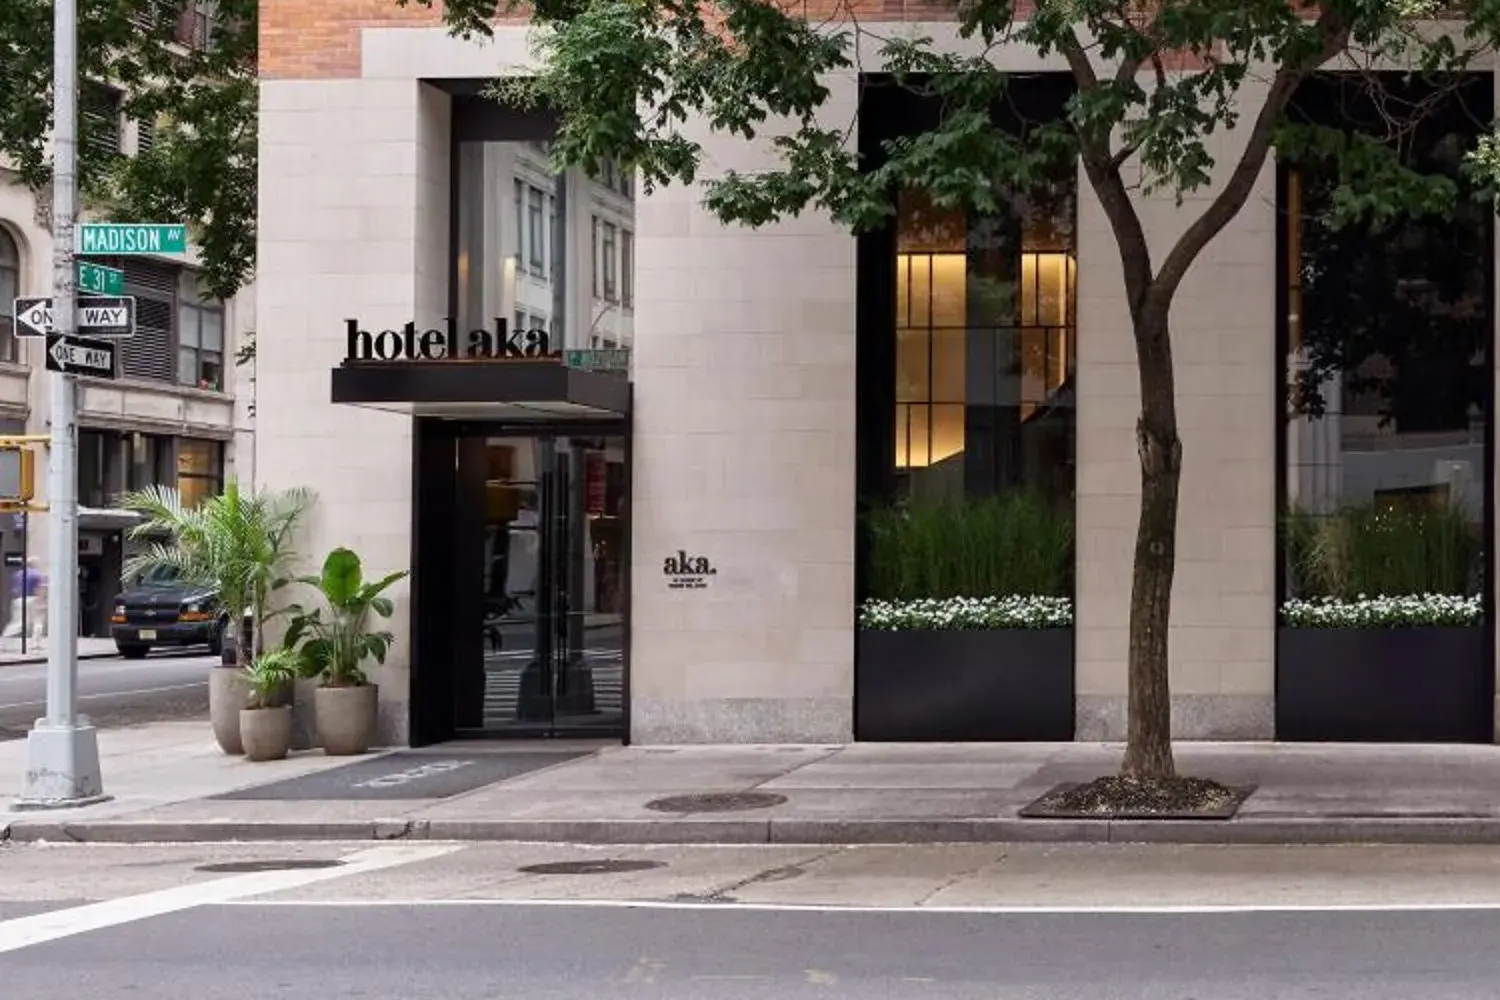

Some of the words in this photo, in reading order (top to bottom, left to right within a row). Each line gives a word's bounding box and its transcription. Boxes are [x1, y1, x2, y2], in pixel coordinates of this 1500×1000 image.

[83, 227, 160, 251] MADISON
[167, 228, 181, 241] AV
[79, 264, 89, 287] E
[93, 268, 105, 292] 31
[85, 309, 122, 325] WAY
[344, 318, 458, 360] hotel
[55, 345, 76, 363] ONE
[86, 351, 107, 366] WAY
